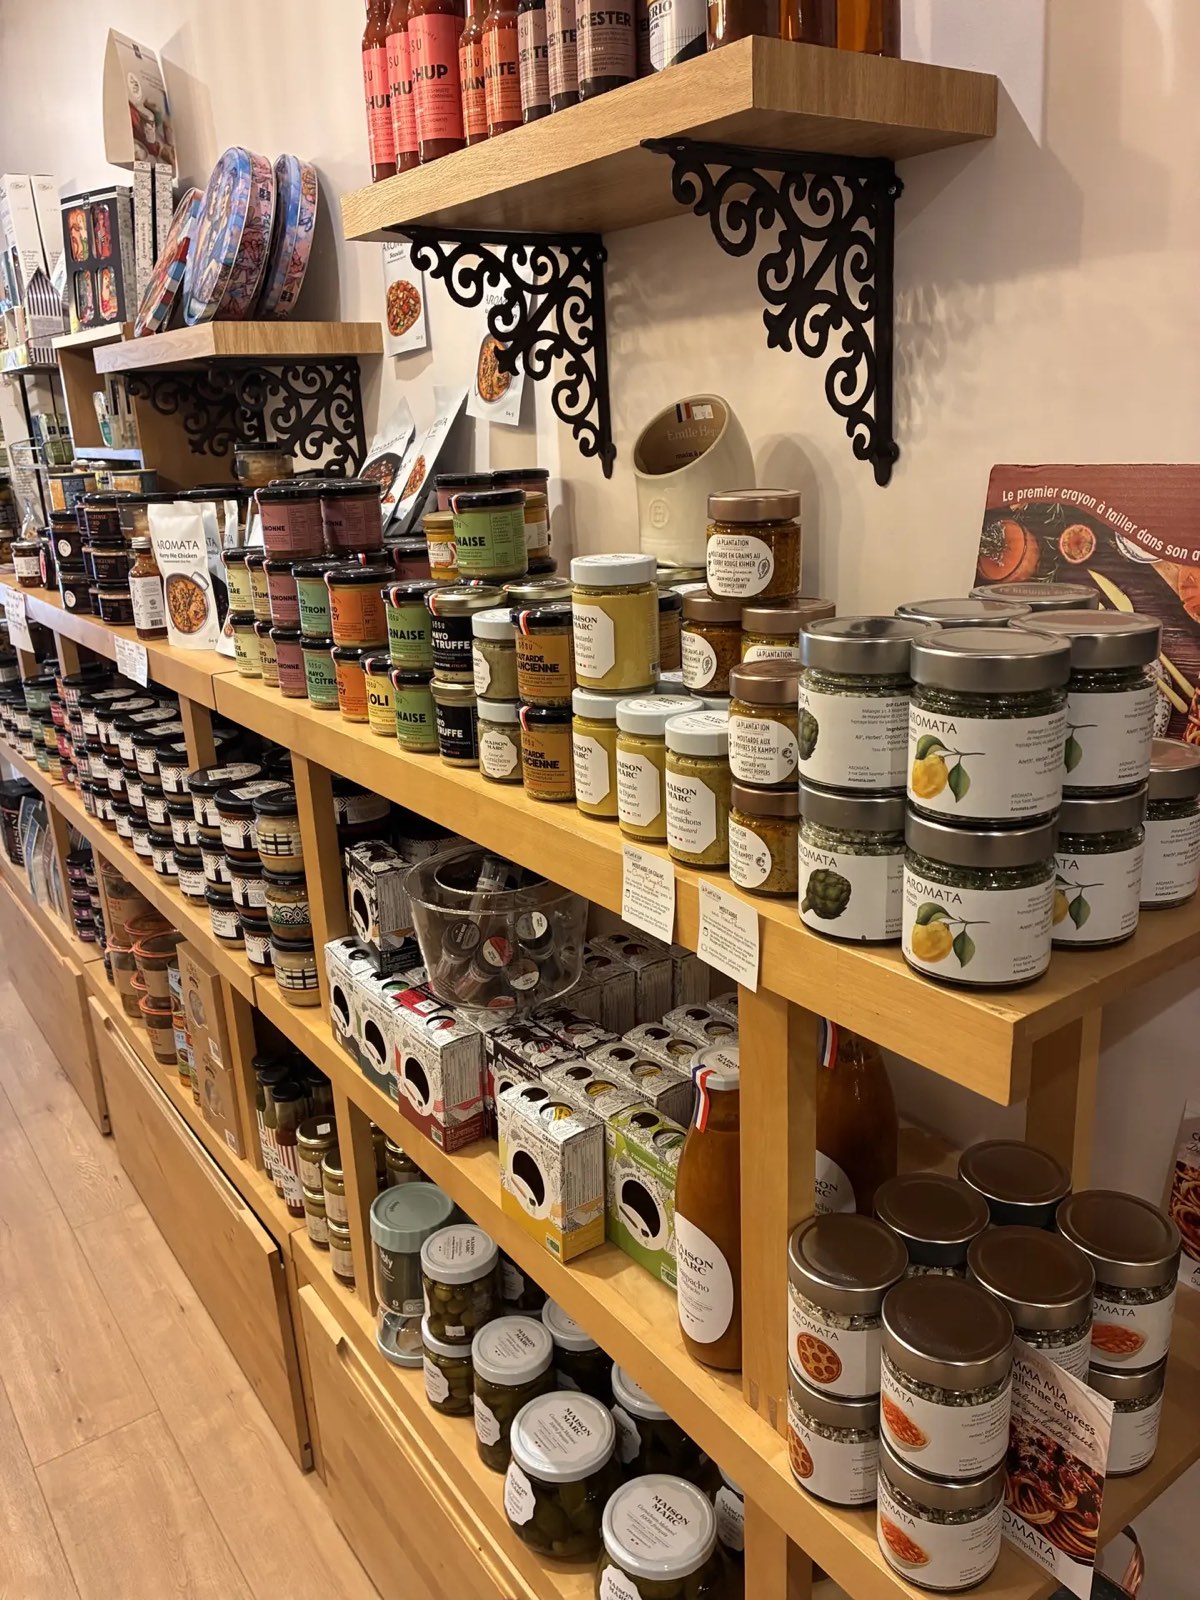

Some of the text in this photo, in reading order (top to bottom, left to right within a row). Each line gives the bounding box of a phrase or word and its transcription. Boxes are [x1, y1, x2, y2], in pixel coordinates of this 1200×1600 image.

[1002, 490, 1014, 502] Le
[1017, 485, 1059, 502] premier
[1061, 488, 1097, 509] crayon
[1097, 501, 1106, 514] à
[1105, 507, 1138, 535] tailler
[1137, 528, 1163, 551] dans
[1165, 544, 1188, 560] son
[722, 539, 750, 547] PLANTATION
[724, 560, 738, 568] ROUGE
[739, 560, 756, 568] KHMER
[735, 552, 753, 560] GRAINS
[436, 640, 471, 650] TRUFFE
[762, 650, 793, 658] PLANTATION
[741, 721, 770, 732] PLANTATION
[758, 746, 780, 754] KAMPOT
[760, 738, 771, 746] AUX
[668, 790, 692, 803] MARC
[671, 811, 702, 827] Cornichons
[906, 875, 963, 905] AROMATA
[792, 1306, 840, 1342] AROMATA
[515, 1332, 530, 1348] MARC
[517, 1328, 536, 1348] MAISON
[1043, 1381, 1069, 1405] MIA
[563, 1414, 585, 1437] MARC
[564, 1407, 593, 1437] MAISON
[1053, 1401, 1096, 1437] express
[651, 1503, 681, 1527] MARC
[652, 1494, 690, 1526] MAISON
